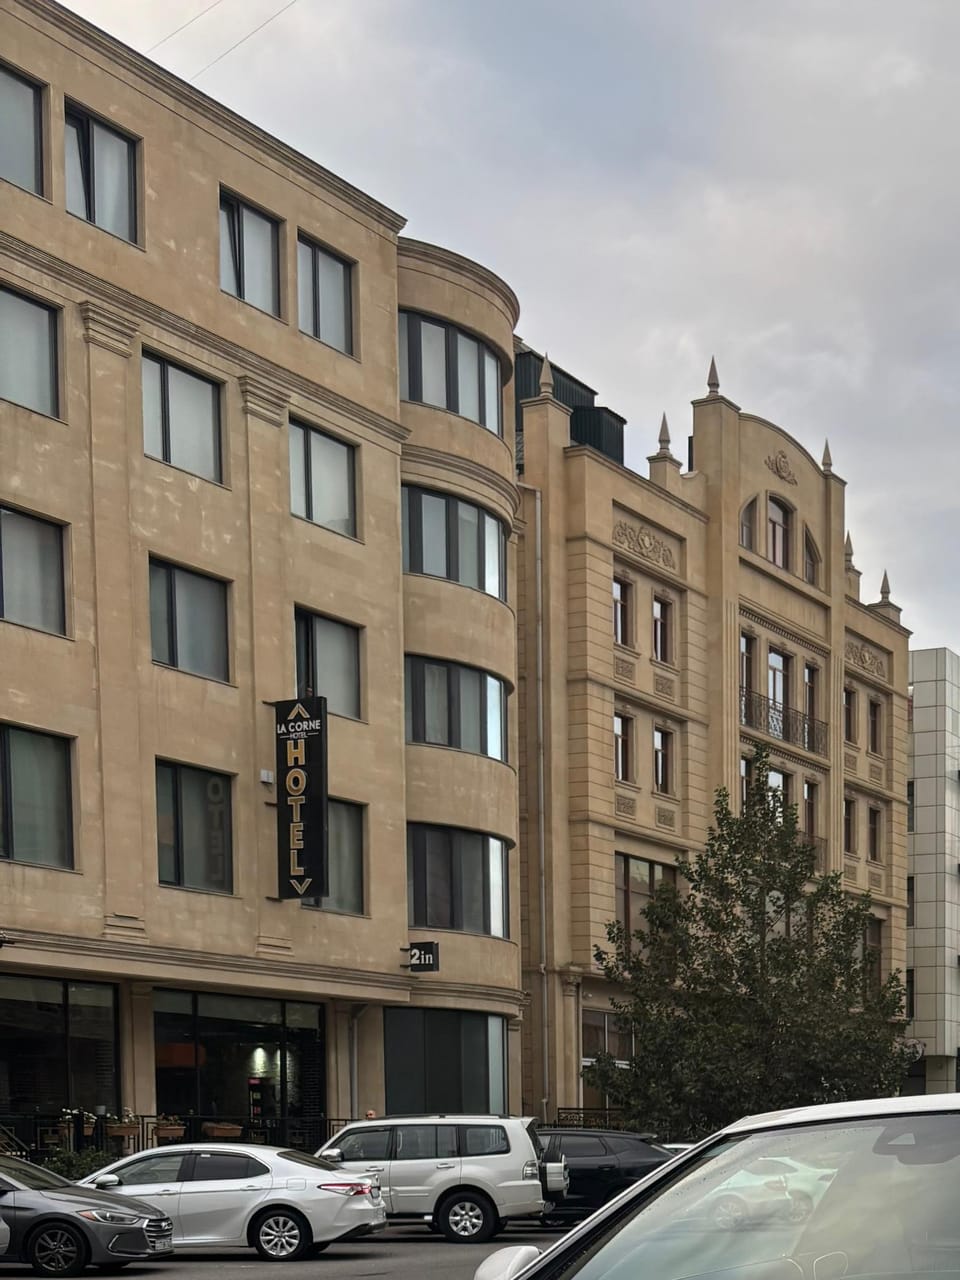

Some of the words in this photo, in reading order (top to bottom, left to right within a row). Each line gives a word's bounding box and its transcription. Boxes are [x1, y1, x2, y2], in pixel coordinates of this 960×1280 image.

[277, 723, 287, 734] LA
[288, 719, 321, 732] CORNE
[286, 739, 307, 876] HOTEL
[410, 949, 433, 964] 2in
